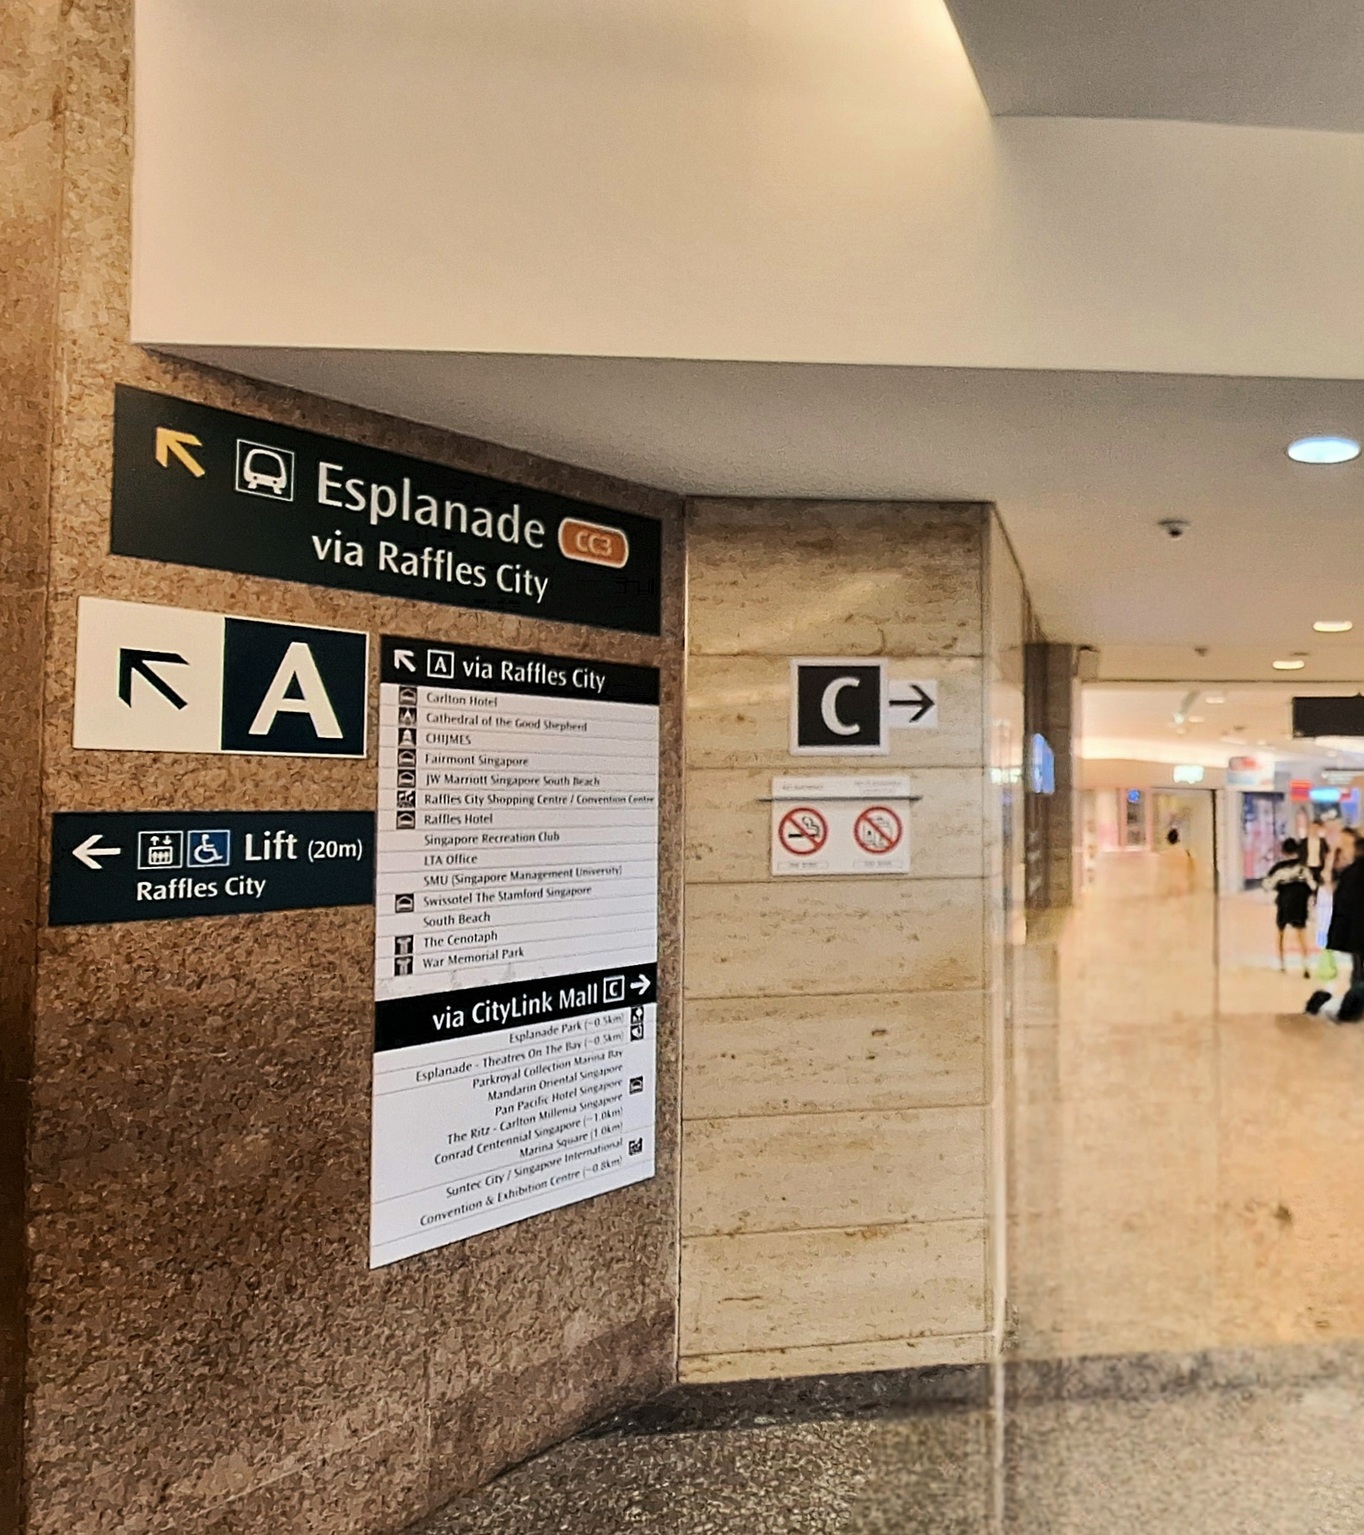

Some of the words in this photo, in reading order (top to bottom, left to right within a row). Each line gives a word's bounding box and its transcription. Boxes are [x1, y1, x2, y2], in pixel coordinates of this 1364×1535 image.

[318, 461, 545, 549] Esplanade
[575, 530, 612, 557] CC3
[312, 530, 363, 568] via
[378, 540, 486, 588] Raffles
[496, 564, 549, 603] City
[434, 657, 447, 672] A
[462, 656, 493, 679] via
[501, 661, 566, 686] Raffles
[572, 668, 605, 693] City
[248, 641, 343, 739] A
[426, 692, 466, 705] Carlton
[470, 696, 497, 707] Hotel
[821, 677, 860, 736] C
[426, 713, 478, 725] Cathedral
[482, 714, 492, 725] of
[496, 716, 512, 727] the
[515, 717, 540, 729] Good
[543, 719, 587, 732] Shepherd
[425, 733, 471, 745] CHIJMES
[425, 754, 475, 765] Fairmont
[479, 754, 529, 769] Singapore
[426, 775, 441, 786] JW
[444, 775, 487, 785] Marriott
[490, 775, 540, 788] Singapore
[543, 776, 570, 786] South
[573, 777, 600, 786] Beach
[424, 794, 461, 804] Raffles
[464, 794, 484, 806] City
[488, 794, 534, 806] Shopping
[537, 794, 566, 804] Centre
[576, 795, 626, 804] Convention
[628, 795, 654, 803] Centre
[424, 814, 461, 825] Raffles
[464, 814, 493, 824] Hotel
[245, 830, 298, 861] Lift
[308, 840, 362, 863] (20m)
[424, 834, 478, 846] Singapore
[482, 833, 535, 844] Recreation
[539, 832, 560, 842] Club
[424, 855, 442, 866] LTA
[446, 854, 477, 865] Office
[136, 878, 218, 900] Raffles
[225, 876, 266, 898] City
[424, 874, 448, 886] SMU
[452, 873, 507, 886] (Singapore
[510, 868, 572, 881] Management
[424, 894, 472, 906] Swissotel
[476, 892, 494, 903] The
[498, 889, 543, 901] Stamford
[546, 886, 592, 898] Singapore
[423, 914, 455, 927] South
[458, 912, 490, 924] Beach
[424, 936, 444, 947] The
[447, 931, 498, 946] Cenotaph
[423, 957, 444, 968] War
[448, 950, 499, 965] Memorial
[502, 947, 524, 959] Park
[432, 1006, 464, 1030] via
[472, 993, 552, 1025] CityLink
[559, 983, 598, 1010] Mall
[609, 982, 618, 996] C
[509, 1027, 559, 1044] Esplanade
[561, 1022, 582, 1033] Park
[416, 1063, 473, 1082] Esplanade
[483, 1053, 526, 1067] Theatres
[528, 1049, 542, 1059] On
[546, 1044, 563, 1055] The
[565, 1040, 582, 1052] Bay
[472, 1070, 521, 1089] Parkroyal
[523, 1059, 571, 1079] Collection
[574, 1053, 604, 1066] Marina
[607, 1049, 624, 1060] Bay
[487, 1083, 537, 1101] Mandarin
[539, 1073, 578, 1090] Oriental
[580, 1063, 623, 1081] Singapore
[495, 1104, 515, 1117] Pan
[517, 1096, 549, 1112] Pacific
[552, 1089, 578, 1102] Hotel
[580, 1078, 623, 1098] Singapore
[447, 1131, 467, 1145] The
[470, 1126, 491, 1139] Ritz
[499, 1115, 536, 1132] Carlton
[539, 1105, 576, 1122] Millenia
[579, 1092, 623, 1112] Singapore
[434, 1147, 473, 1165] Conrad
[476, 1131, 532, 1152] Centennial
[535, 1118, 581, 1138] Singapore
[519, 1143, 554, 1158] Marina
[557, 1132, 588, 1149] Square
[446, 1181, 482, 1198] Suntec
[485, 1173, 505, 1187] City
[514, 1157, 562, 1177] Singapore
[565, 1138, 623, 1162] International
[420, 1200, 483, 1227] Convention
[485, 1194, 494, 1205] &
[497, 1181, 548, 1203] Exhibition
[550, 1171, 580, 1187] Centre
